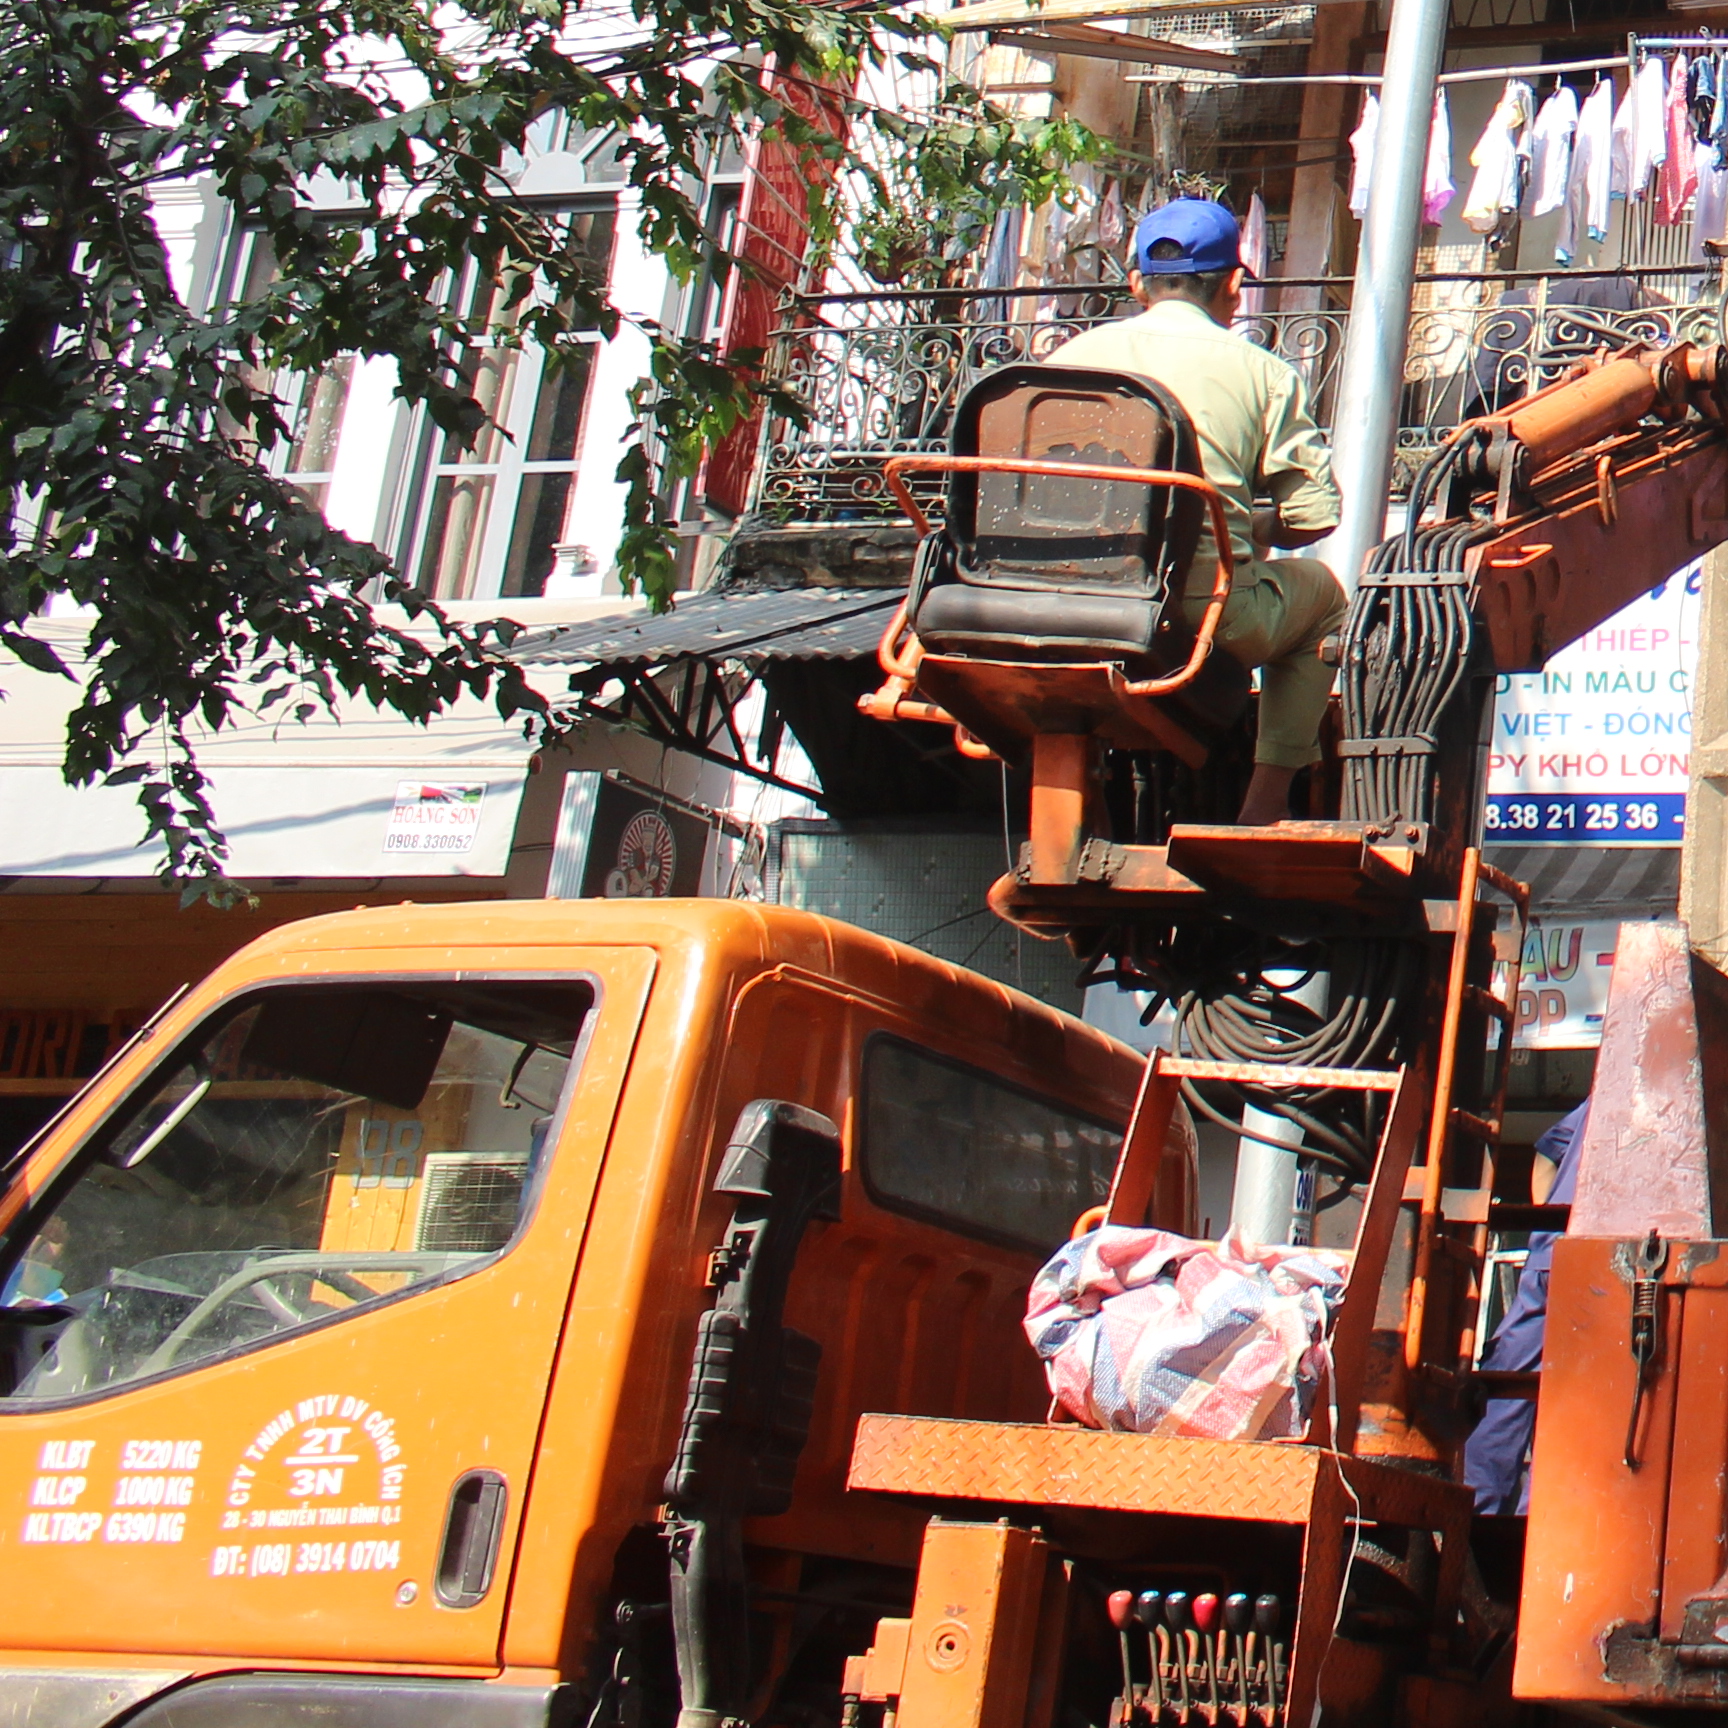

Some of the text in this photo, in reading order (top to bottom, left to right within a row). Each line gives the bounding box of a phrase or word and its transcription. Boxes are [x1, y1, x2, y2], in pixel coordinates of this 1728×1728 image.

[1544, 671, 1572, 694] IN
[1585, 665, 1657, 693] MÀU
[1502, 709, 1570, 741] VIỆT
[1547, 804, 1576, 827] 21
[1586, 803, 1619, 827] 25
[1625, 803, 1658, 827] 36
[352, 1118, 423, 1189] 98
[41, 1440, 96, 1469] KLBT
[229, 1463, 256, 1506] CTY
[245, 1409, 296, 1461] TNHH
[297, 1394, 340, 1423] MTV
[340, 1395, 370, 1421] DV
[380, 1463, 407, 1500] ÍCH
[298, 1426, 351, 1454] 2T
[33, 1476, 87, 1505] KLCP
[289, 1468, 344, 1496] 3N
[24, 1512, 103, 1542] KLTBCP
[250, 1510, 266, 1528] 30
[350, 1503, 380, 1524] BÌNH
[381, 1505, 402, 1525] Q.1
[213, 1540, 401, 1577] ĐT: (08) 3914 0704
